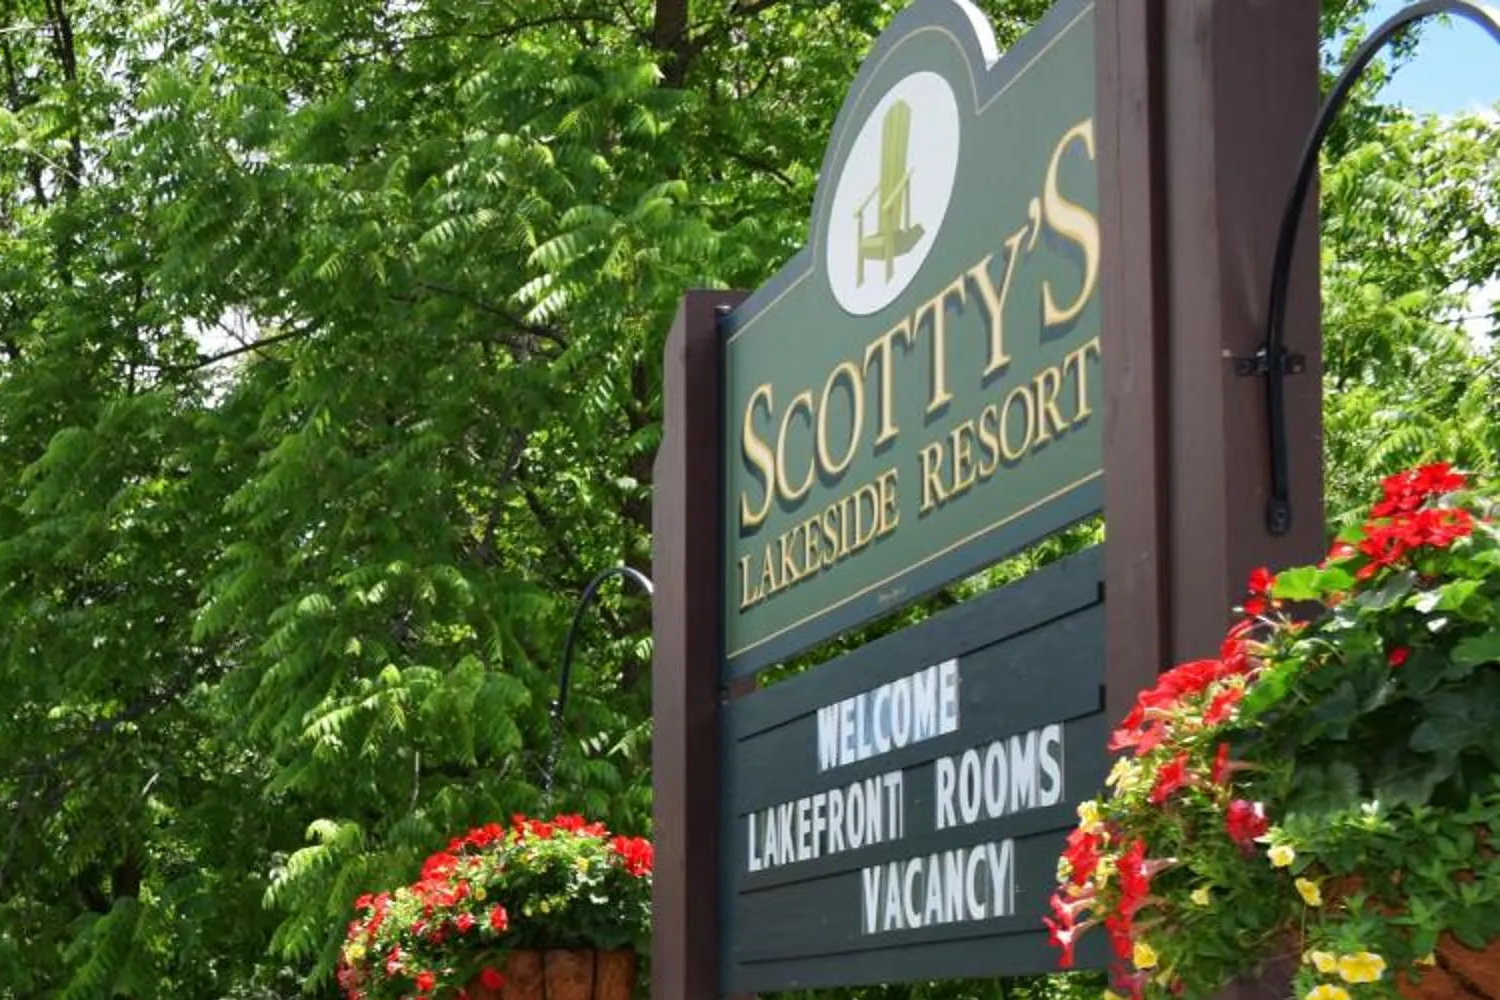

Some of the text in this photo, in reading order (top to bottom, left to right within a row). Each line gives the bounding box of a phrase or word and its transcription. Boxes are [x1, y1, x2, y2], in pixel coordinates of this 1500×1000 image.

[739, 116, 1101, 527] SCOTTY'S
[739, 336, 1100, 610] LAKESIDE RESORT
[817, 658, 958, 770] WELCOME
[748, 724, 1062, 872] LAKEFRONT ROOMS
[862, 842, 1013, 934] VACANCY
